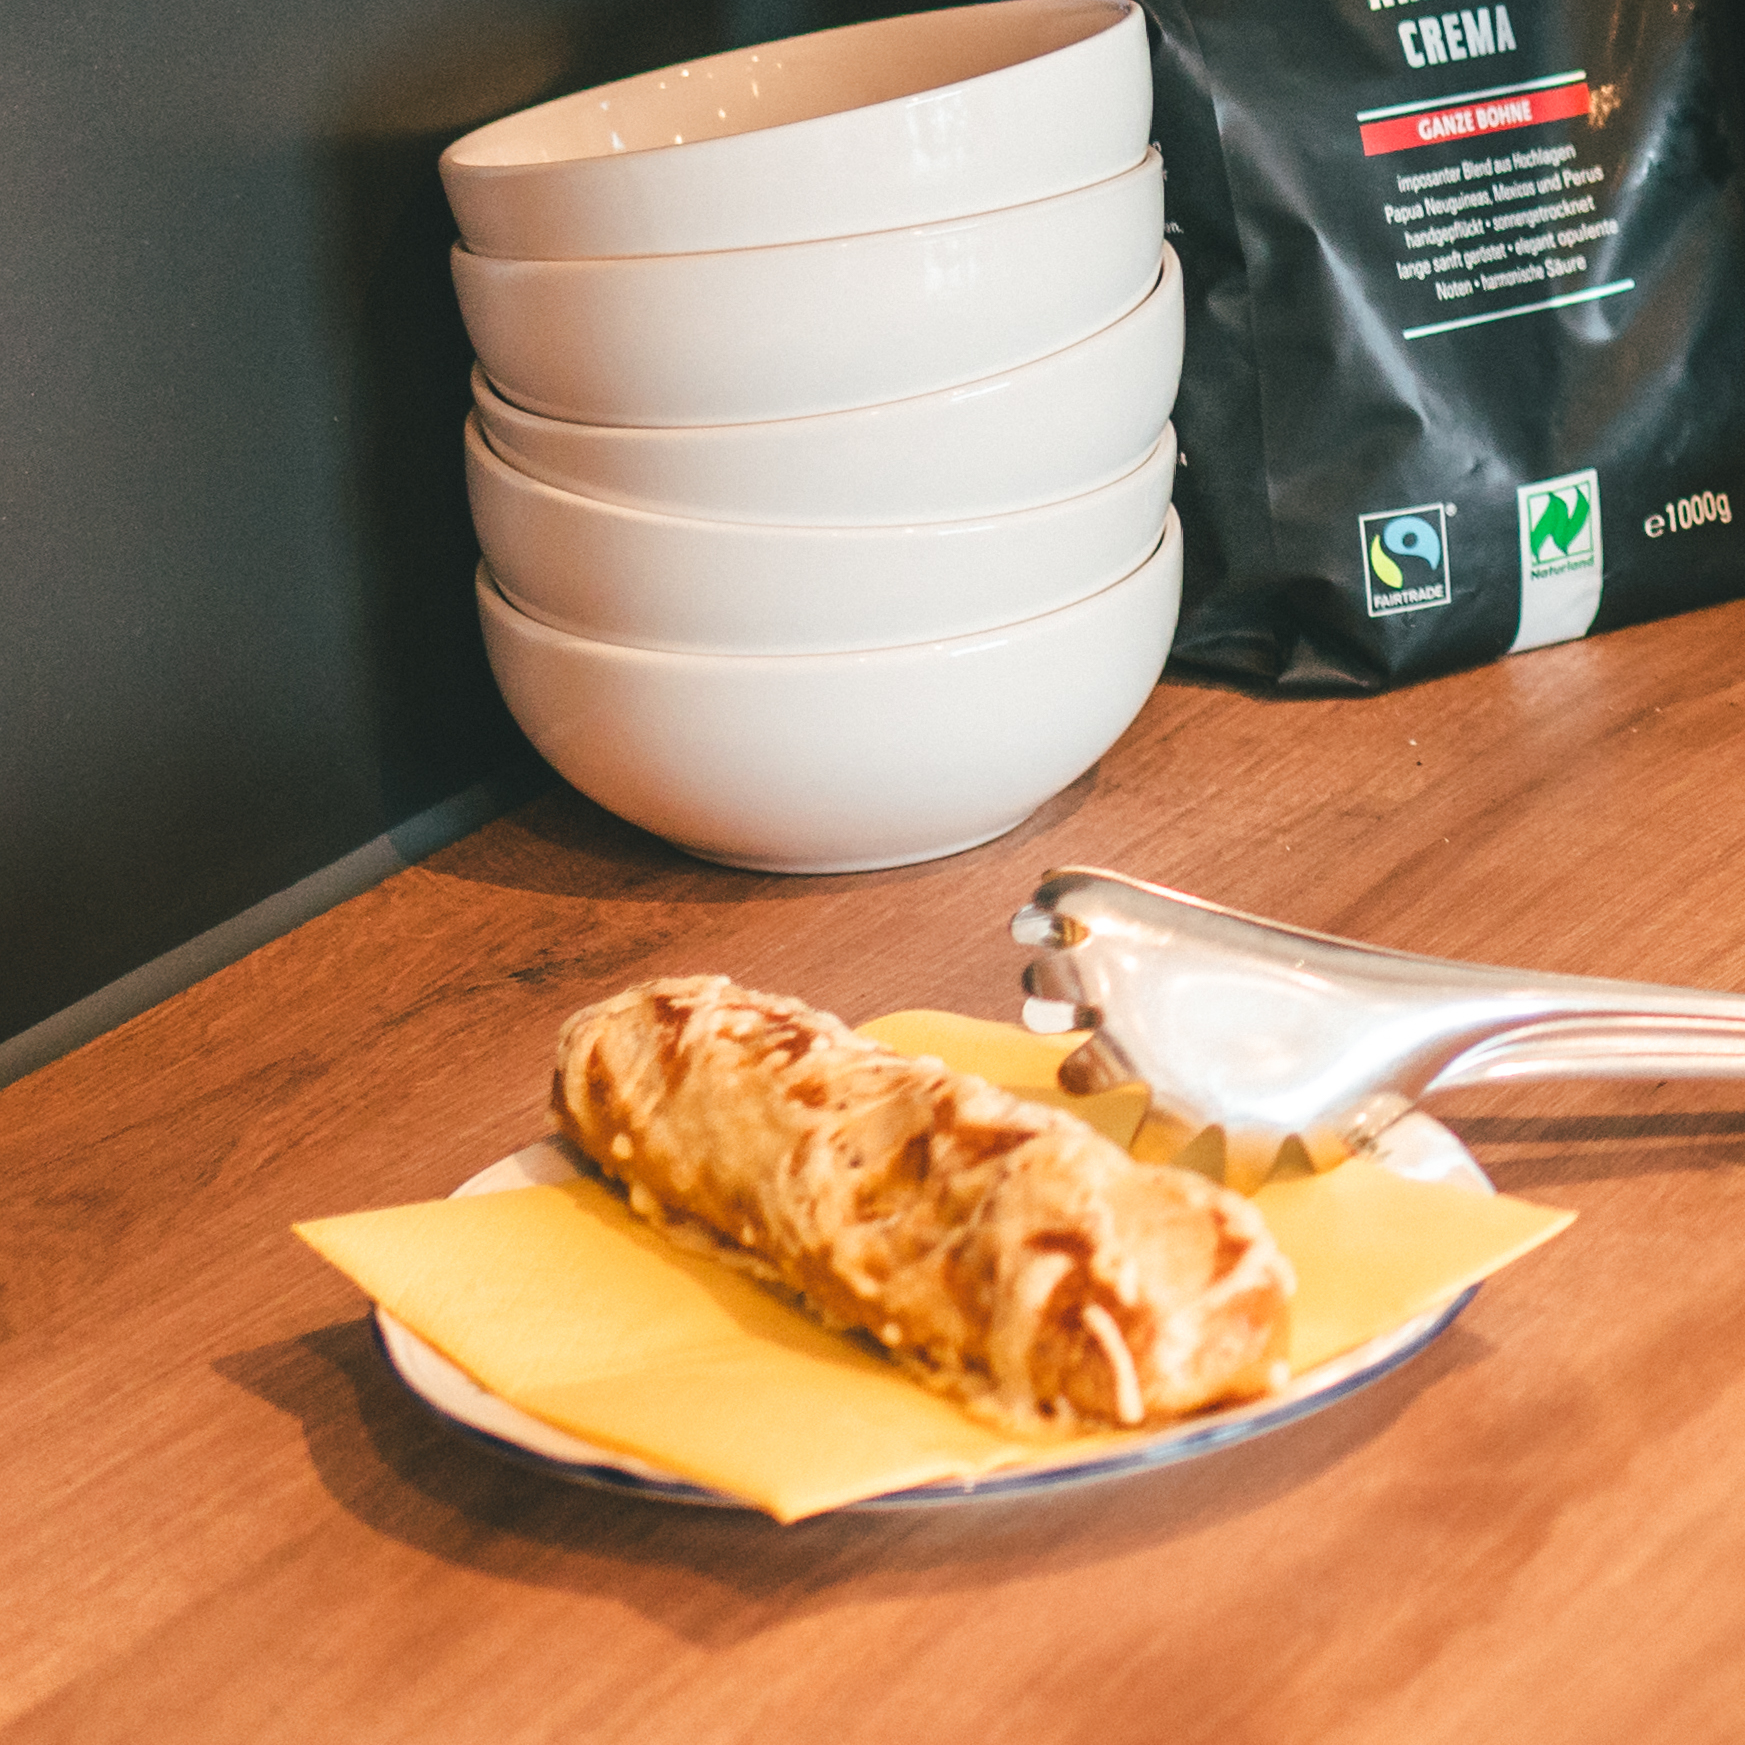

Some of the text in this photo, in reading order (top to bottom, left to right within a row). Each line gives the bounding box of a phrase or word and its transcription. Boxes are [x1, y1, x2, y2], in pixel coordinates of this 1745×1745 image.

[1398, 4, 1517, 69] CREMA
[1417, 99, 1533, 141] GANZE BOHNE
[1397, 144, 1577, 194] imposanter Blend aus Hochlagen
[1384, 203, 1425, 225] Papua
[1492, 180, 1536, 203] Mexicos
[1536, 172, 1563, 193] und
[1562, 165, 1605, 189] Perus
[1404, 194, 1596, 249] handgepflückt sonnengetrocknet
[1396, 219, 1620, 281] lange sanft geröstet elegant opulente
[1434, 255, 1588, 302] Noten harmonische Säure
[1530, 556, 1596, 582] Naturland
[1373, 584, 1445, 610] FAIRTRADE
